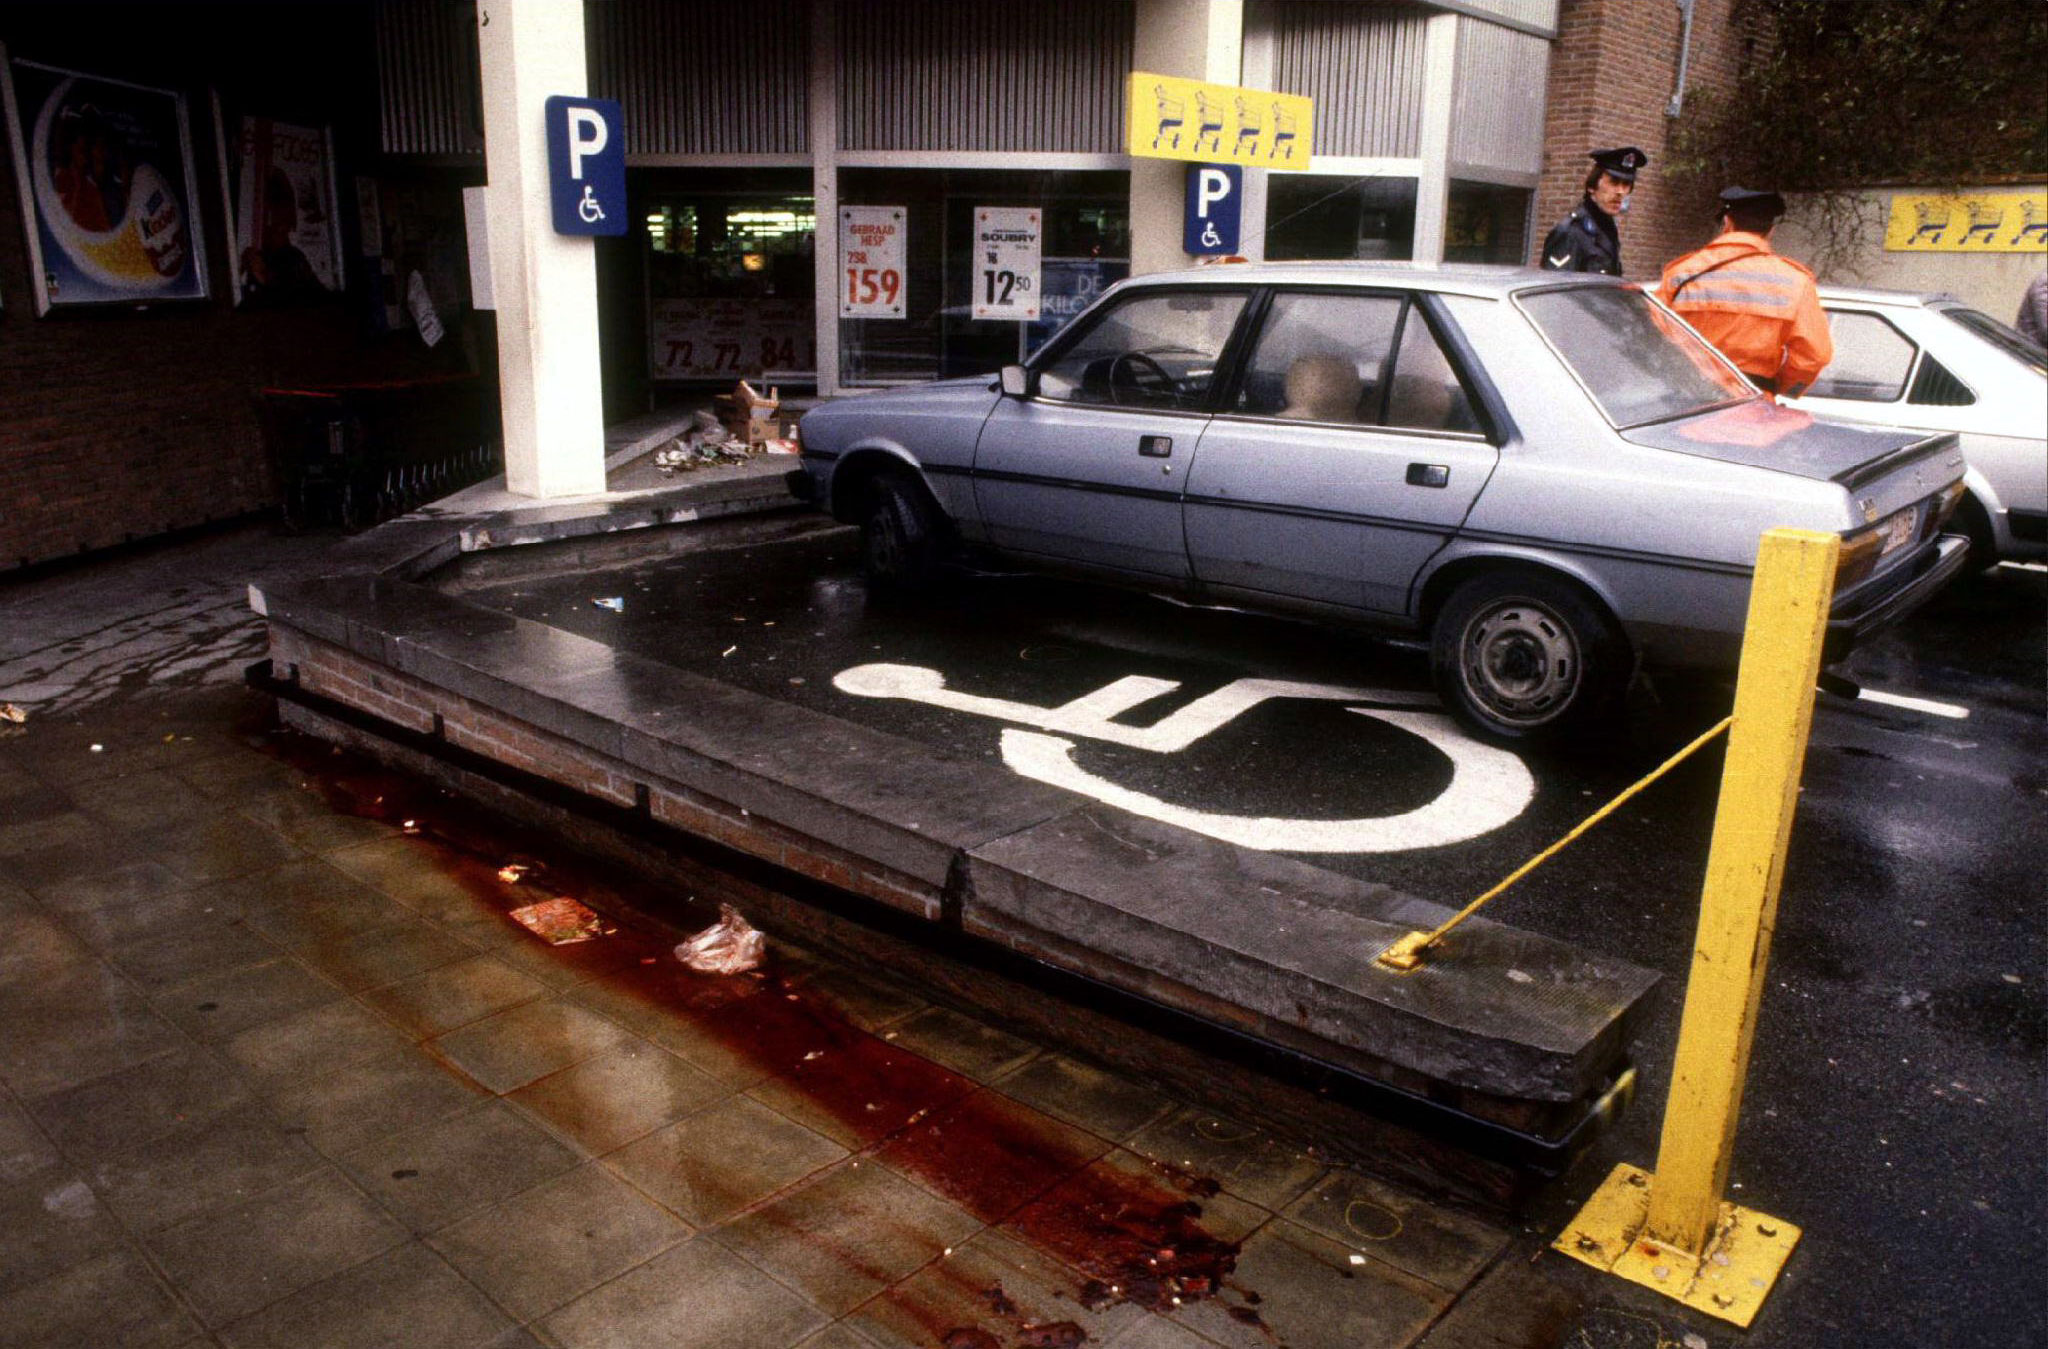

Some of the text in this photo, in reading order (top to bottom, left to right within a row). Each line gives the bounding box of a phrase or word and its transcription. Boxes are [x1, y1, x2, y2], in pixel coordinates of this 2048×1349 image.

[567, 106, 608, 180] P
[1198, 168, 1231, 218] P
[849, 224, 896, 236] GEBRAAD
[860, 235, 885, 247] HESP
[981, 232, 1036, 242] SOUBRY
[847, 269, 900, 305] 159
[1078, 273, 1103, 295] DE
[666, 341, 693, 367] 72
[714, 343, 742, 370] 72
[760, 338, 795, 368] 84
